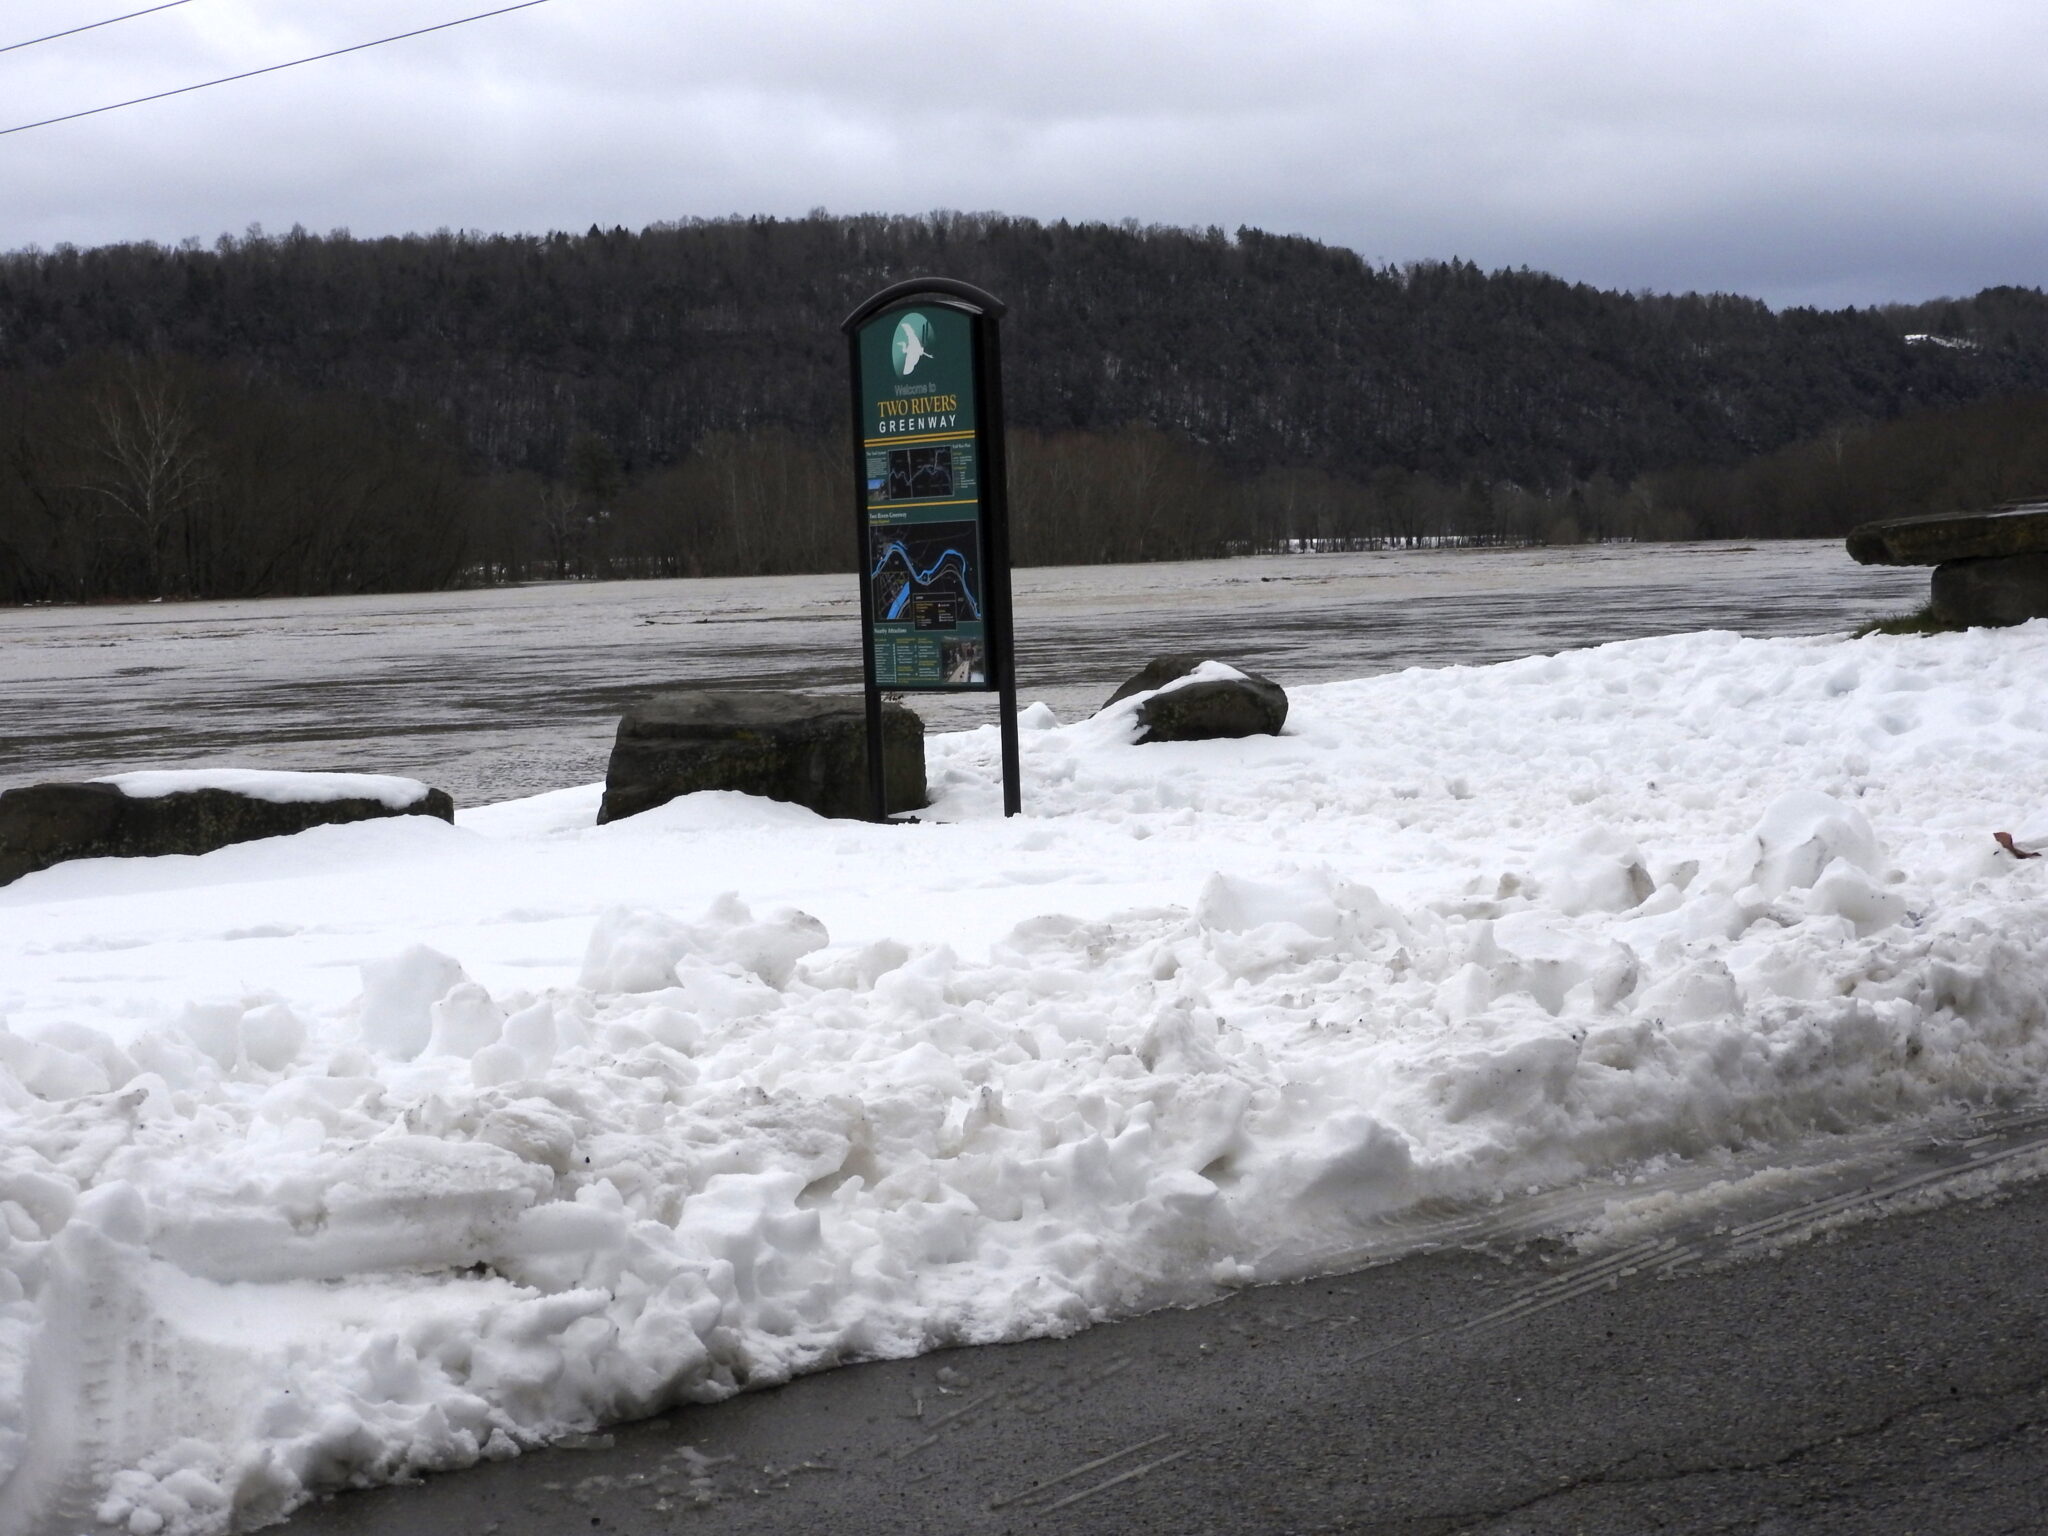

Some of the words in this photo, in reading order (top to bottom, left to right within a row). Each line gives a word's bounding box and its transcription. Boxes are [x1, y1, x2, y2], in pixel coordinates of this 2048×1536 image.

[895, 384, 927, 396] Welcome
[929, 382, 936, 392] to
[878, 401, 908, 418] TWO
[912, 394, 957, 414] RIVERS
[879, 414, 956, 433] GREENWAY
